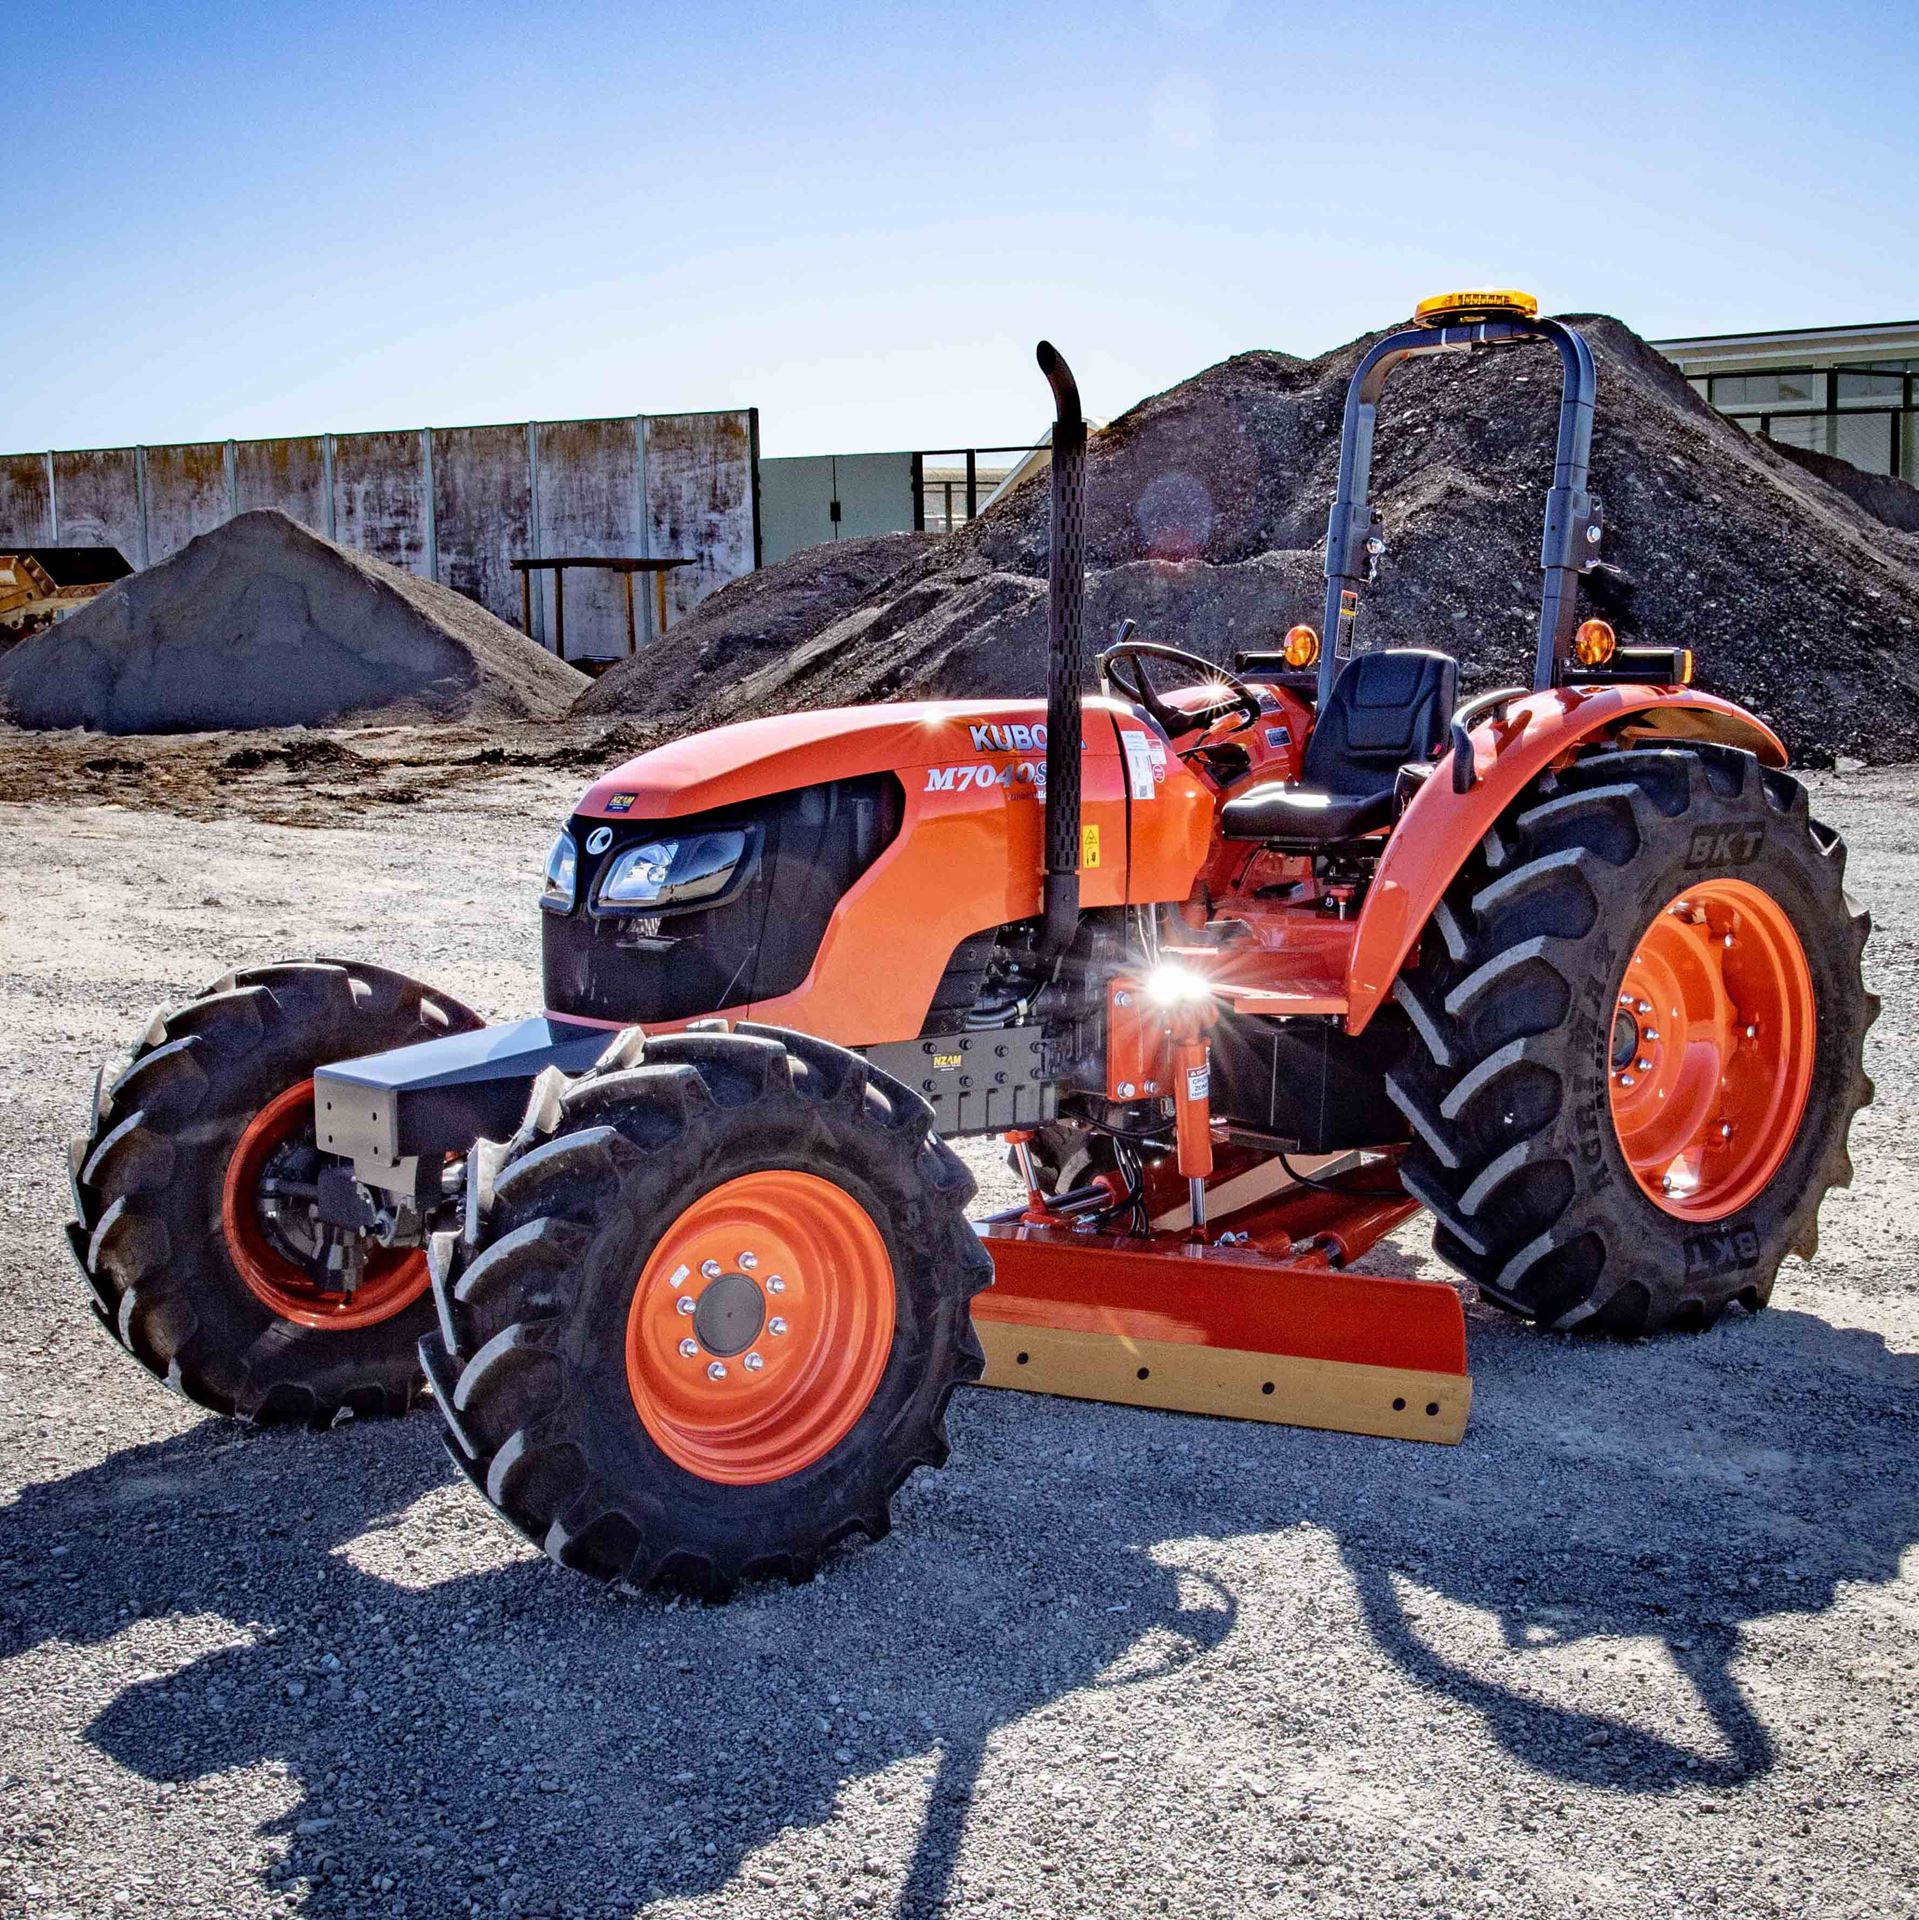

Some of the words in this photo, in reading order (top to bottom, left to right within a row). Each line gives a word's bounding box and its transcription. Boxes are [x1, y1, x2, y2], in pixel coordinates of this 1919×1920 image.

[969, 723, 1086, 752] KUBO
[1688, 831, 1763, 864] BKT
[933, 1055, 962, 1066] NZAM
[1688, 1231, 1759, 1273] BKT
